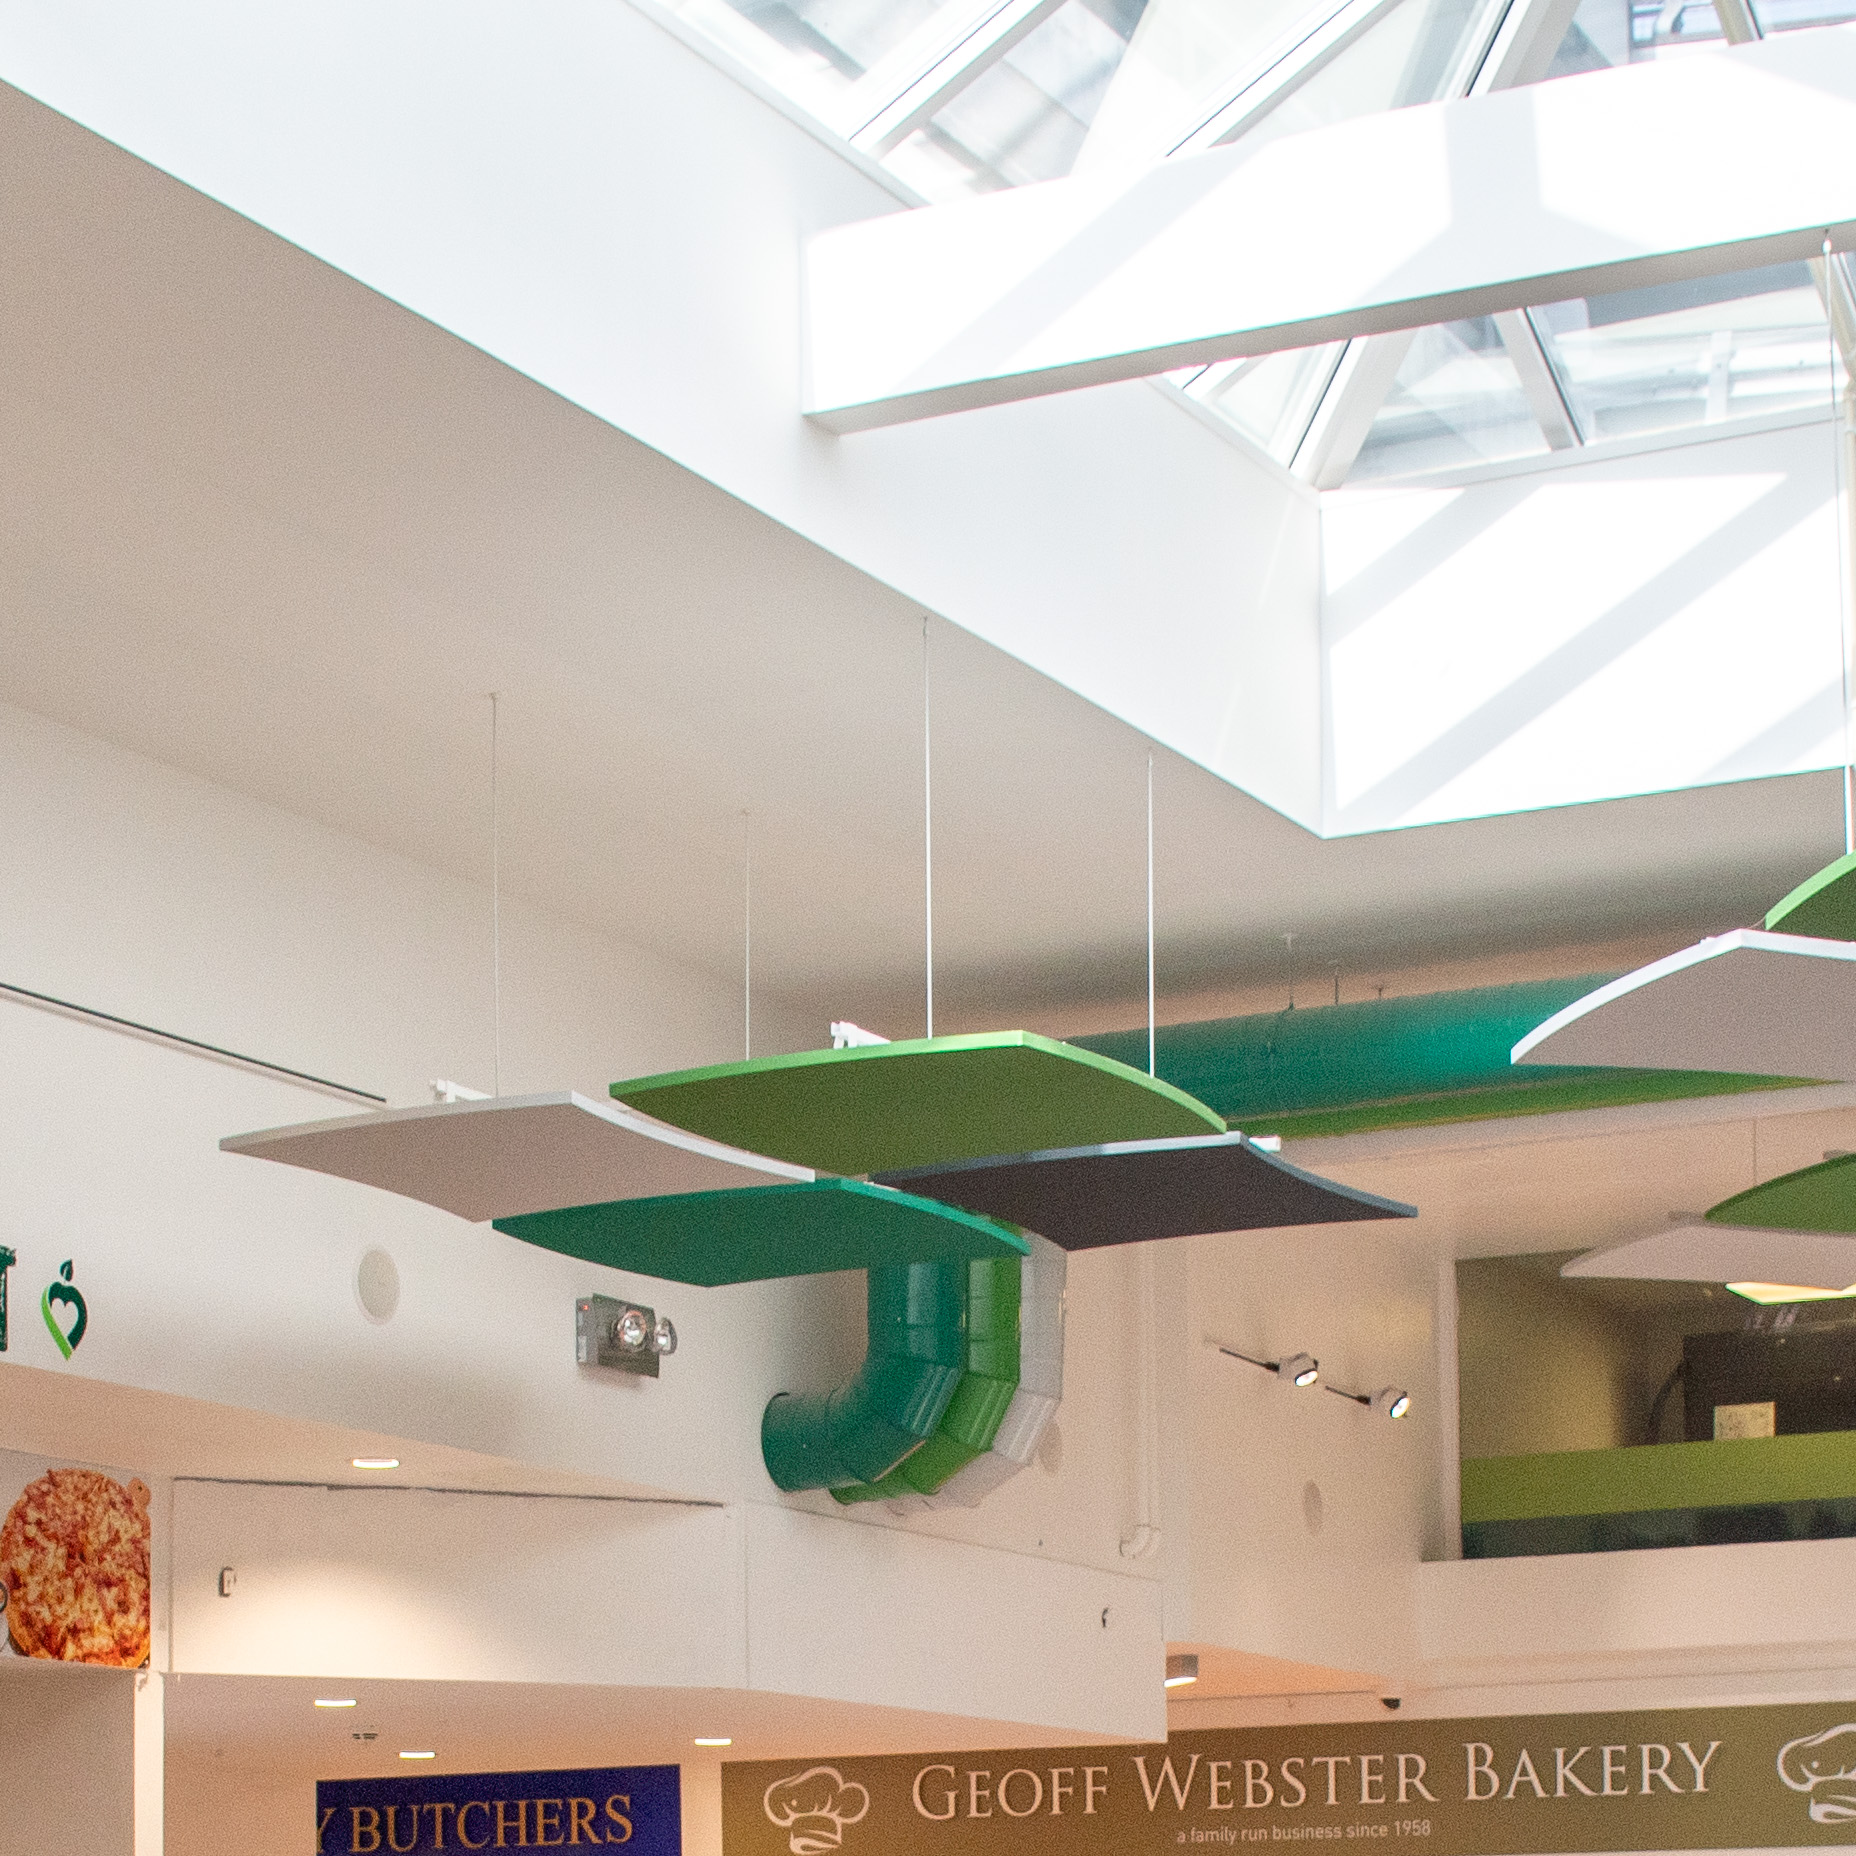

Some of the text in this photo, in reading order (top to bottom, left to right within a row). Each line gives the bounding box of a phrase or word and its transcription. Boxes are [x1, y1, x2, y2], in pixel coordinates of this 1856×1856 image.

[912, 1740, 1723, 1821] GEOFF WEBSTER BAKERY
[349, 1795, 633, 1854] BUTCHERS
[1177, 1819, 1431, 1846] a family run business since 1958
